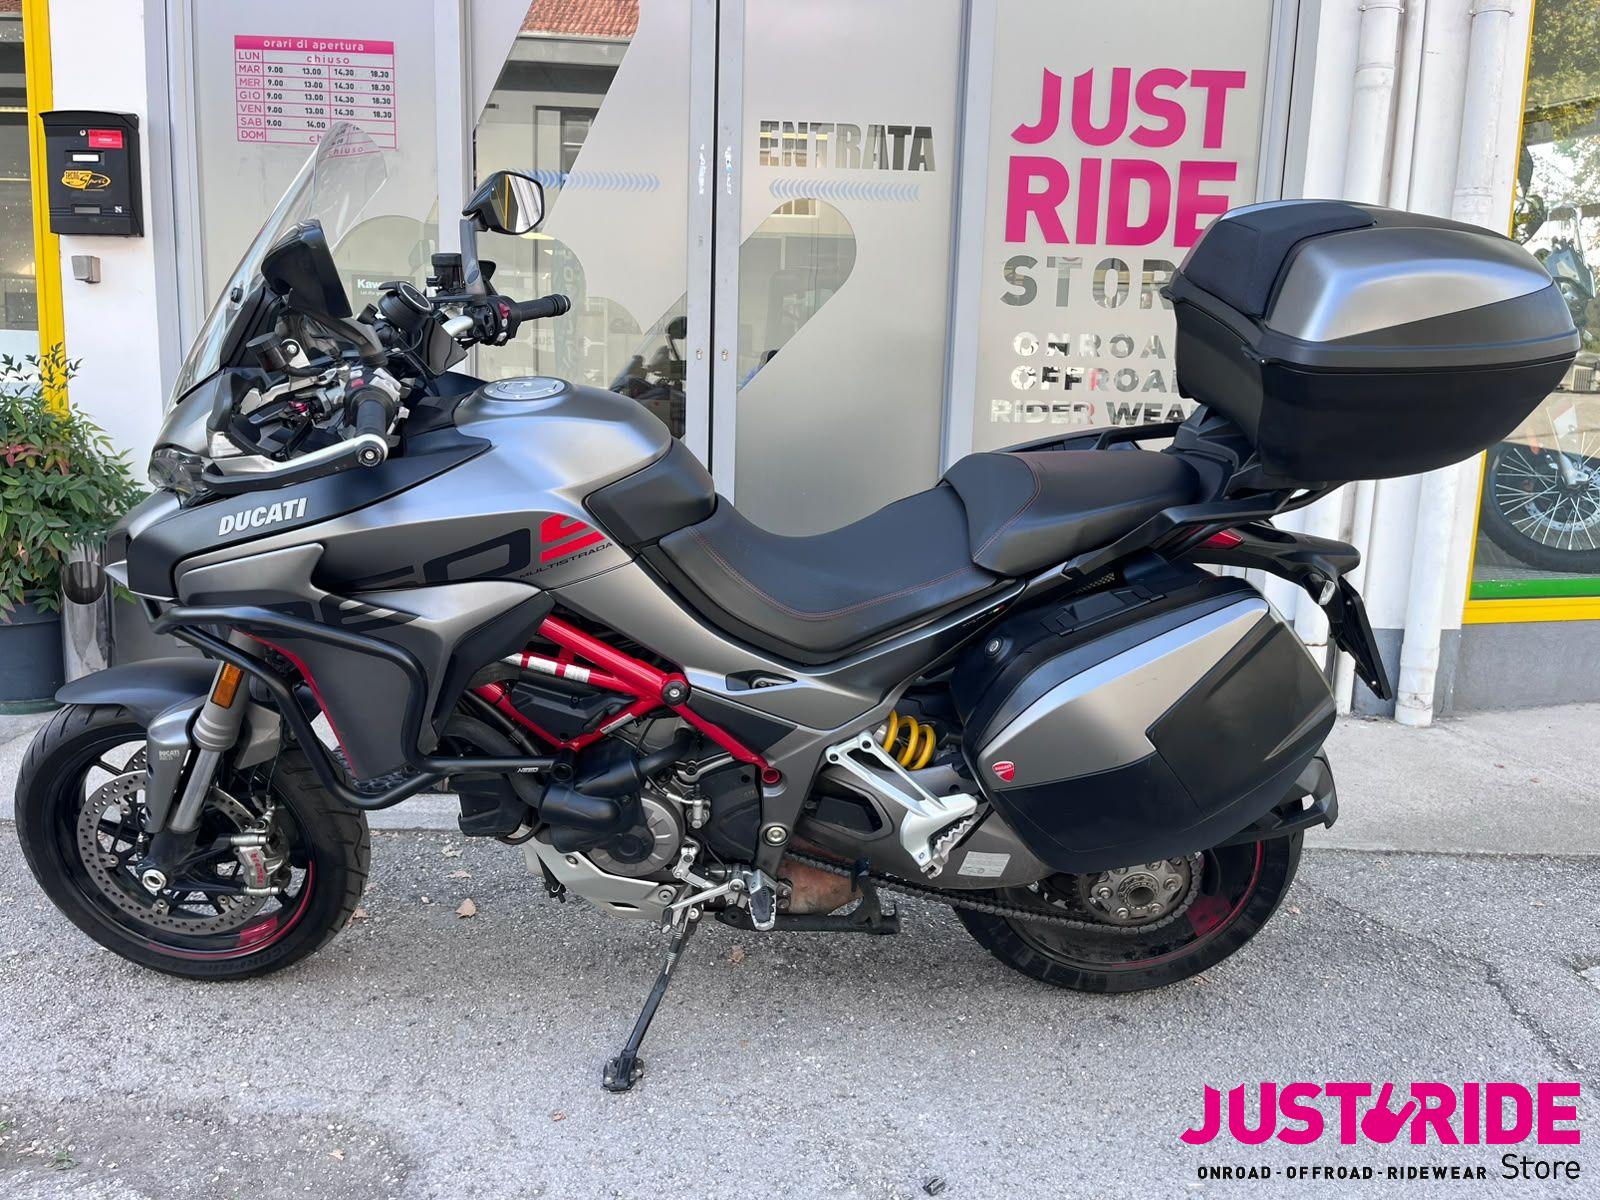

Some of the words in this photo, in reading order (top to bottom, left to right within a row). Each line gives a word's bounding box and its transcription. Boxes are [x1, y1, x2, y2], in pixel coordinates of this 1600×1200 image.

[238, 51, 260, 60] LUN
[306, 54, 350, 64] chiuso
[263, 38, 292, 48] orari
[296, 38, 308, 49] di
[312, 41, 364, 52] apertura
[238, 64, 260, 73] MAR
[267, 66, 284, 74] 9.00
[302, 68, 322, 76] 13.00
[334, 68, 355, 76] 14.30
[239, 78, 260, 86] MER
[267, 79, 284, 87] 9.00
[304, 81, 323, 89] 13.00
[334, 82, 355, 90] 14.30
[371, 84, 390, 92] 18.30
[239, 91, 261, 100] GIO
[266, 92, 283, 100] 9.00
[304, 93, 324, 102] 13.00
[334, 95, 355, 104] 14.30
[372, 97, 391, 105] 18.30
[240, 104, 262, 113] VEN
[266, 106, 283, 114] 9.00
[305, 107, 324, 115] 13.00
[334, 108, 355, 117] 14.30
[373, 110, 392, 119] 18.30
[1010, 67, 1247, 149] JUST
[240, 117, 262, 126] SAB
[266, 119, 282, 127] 9.00
[306, 120, 326, 129] 14.00
[241, 130, 264, 139] DOM
[759, 119, 936, 172] ENTRATA
[1005, 155, 1238, 248] RIDE
[1000, 255, 1178, 310] STOR
[1013, 331, 1167, 360] ONROA
[1010, 365, 1178, 393] OFFROA
[990, 399, 1096, 425] RIDER
[218, 497, 308, 536] DUCATI
[520, 542, 613, 578] MULTISTRADA
